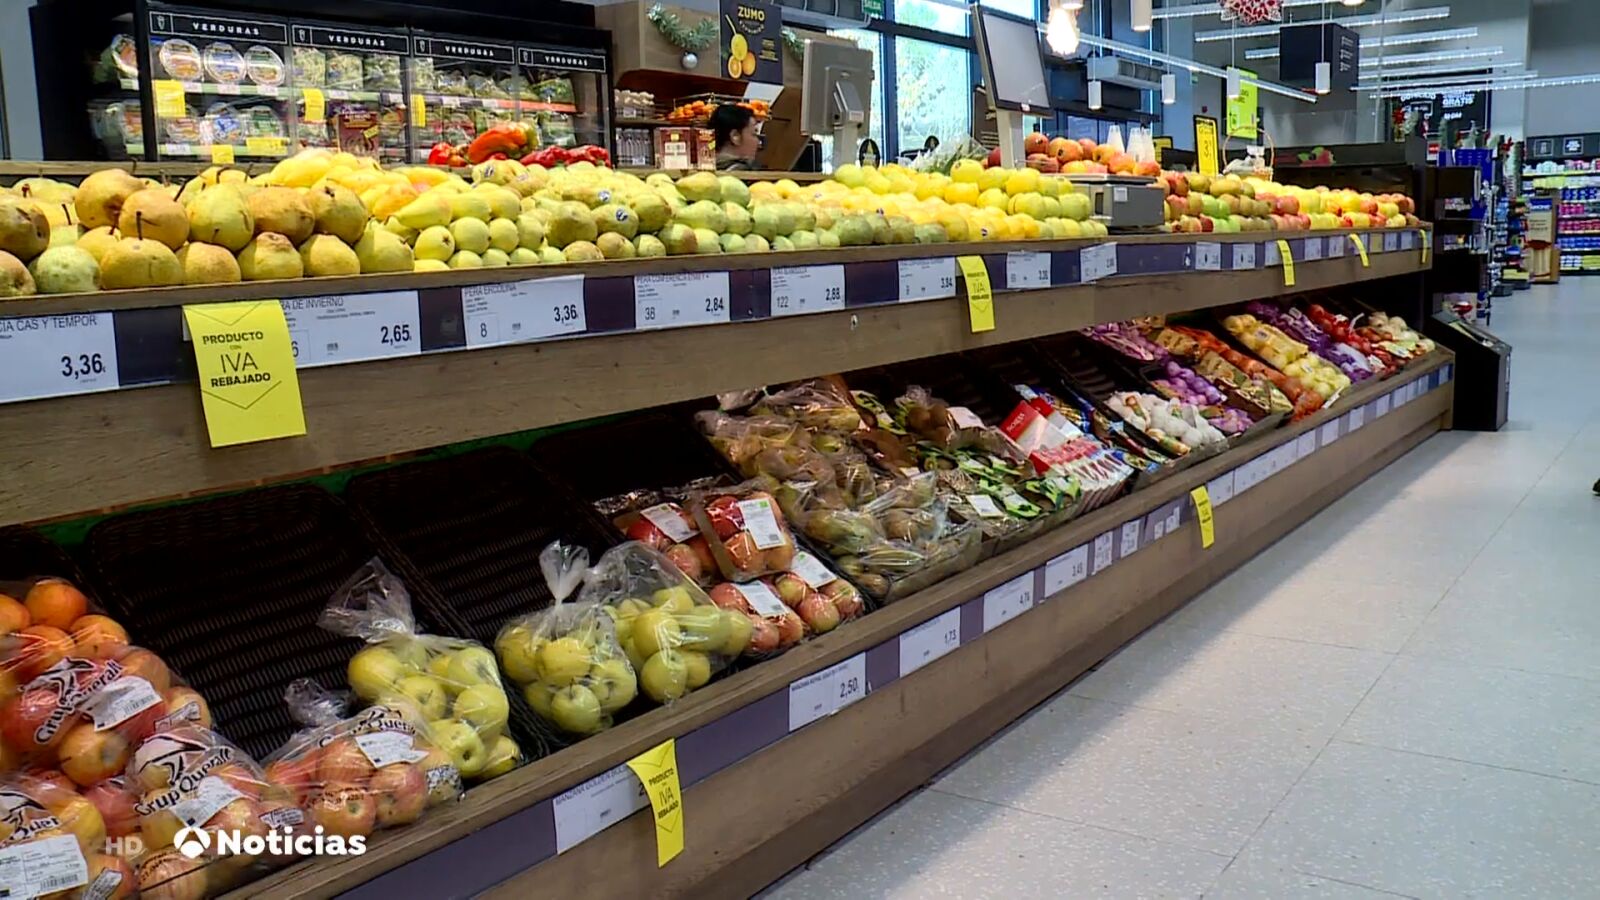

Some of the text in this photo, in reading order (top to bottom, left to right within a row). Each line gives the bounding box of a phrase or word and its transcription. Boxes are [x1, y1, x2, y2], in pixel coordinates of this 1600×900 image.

[738, 6, 765, 21] ZUMO
[193, 22, 260, 36] VERDURAS
[328, 35, 385, 47] VERDURAS
[445, 45, 494, 57] VERDURAS
[545, 56, 588, 67] VERDURAS
[292, 299, 304, 310] DE
[305, 296, 344, 309] INVIERNO
[645, 306, 655, 320] 38
[16, 318, 39, 332] CAS
[41, 318, 49, 329] Y
[52, 315, 98, 329] TEMPOR
[480, 322, 487, 338] 8
[202, 331, 264, 344] PRODUCTO
[220, 352, 259, 373] IVA
[210, 372, 271, 387] REBAJADO
[134, 748, 232, 816] Grup Queralt
[648, 768, 675, 787] PRODUCTO
[659, 786, 675, 807] IVA
[658, 800, 679, 819] REBAJADO
